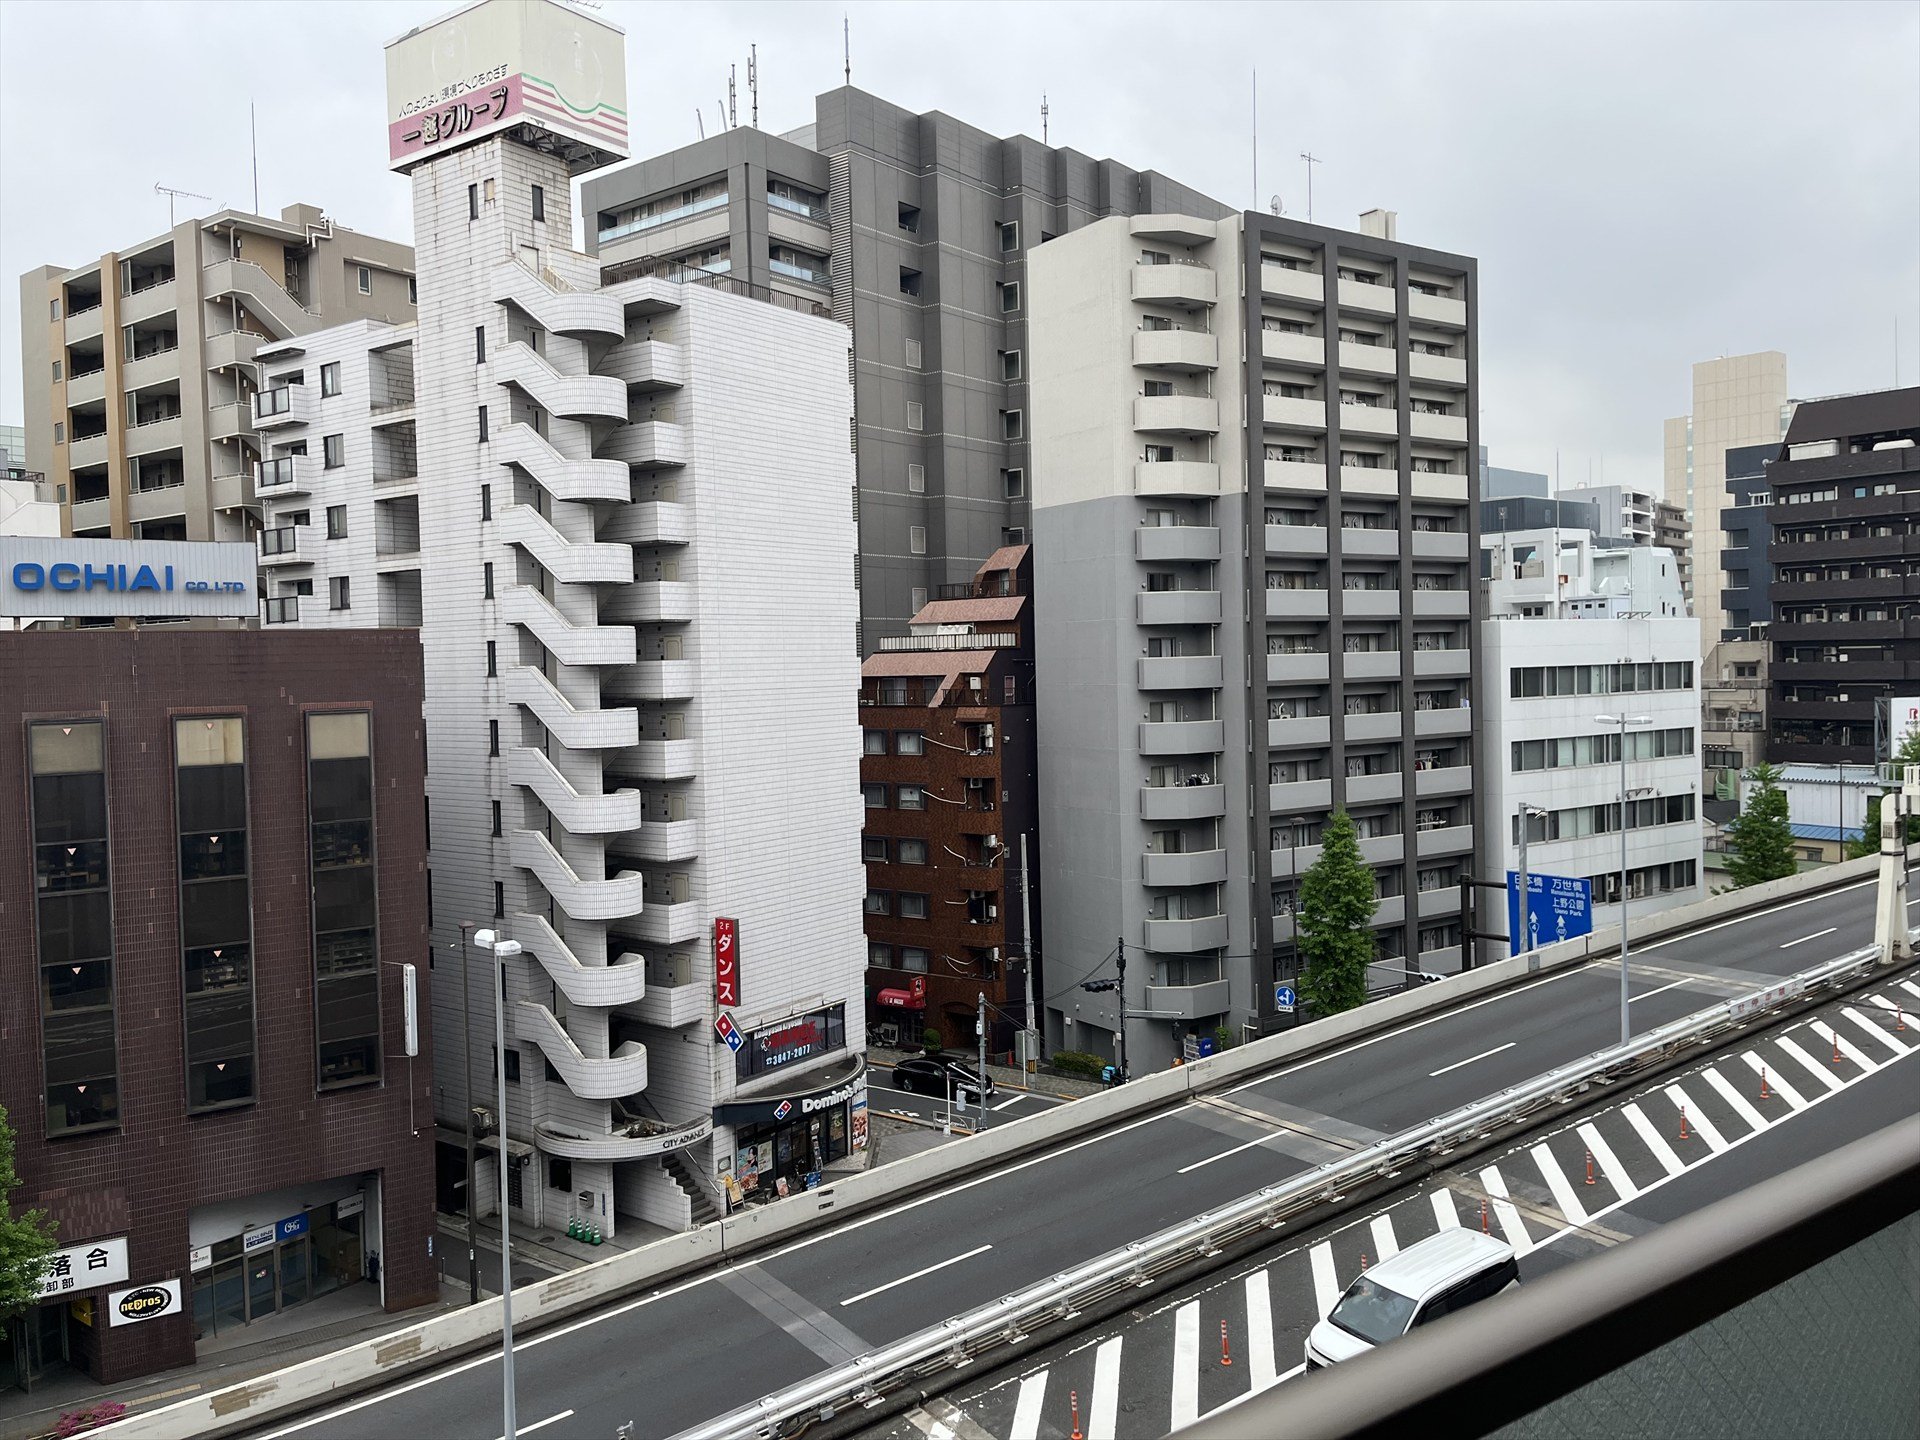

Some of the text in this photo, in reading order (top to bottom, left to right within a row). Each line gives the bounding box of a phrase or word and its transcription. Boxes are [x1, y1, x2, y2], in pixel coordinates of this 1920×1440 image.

[12, 562, 174, 592] OCHIAI
[1552, 879, 1582, 892] 万世橋
[1553, 897, 1584, 910] 上野公園
[719, 921, 730, 931] 2F
[718, 933, 734, 1001] ダンス
[802, 1085, 854, 1113] Domino's
[663, 1138, 679, 1148] CITY
